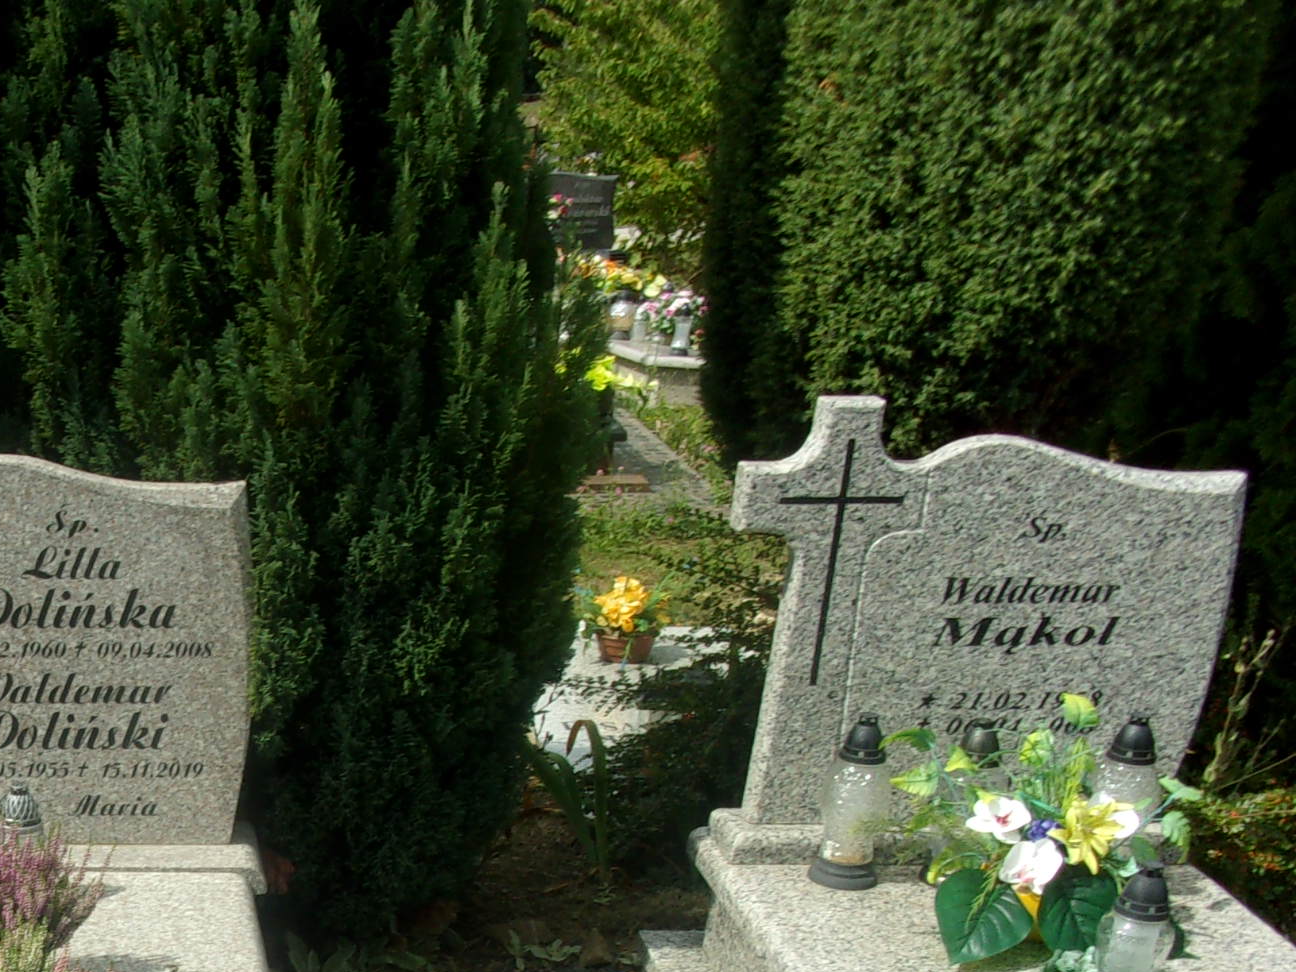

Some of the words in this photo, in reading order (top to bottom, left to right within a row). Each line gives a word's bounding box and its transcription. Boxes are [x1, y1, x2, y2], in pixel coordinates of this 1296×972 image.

[21, 545, 123, 581] Lilla
[940, 575, 1122, 606] Waldemar
[933, 614, 1122, 655] Mąkol
[96, 641, 213, 660] 09.04.2008
[101, 761, 205, 780] 15.11.2019
[68, 793, 160, 818] Maria
